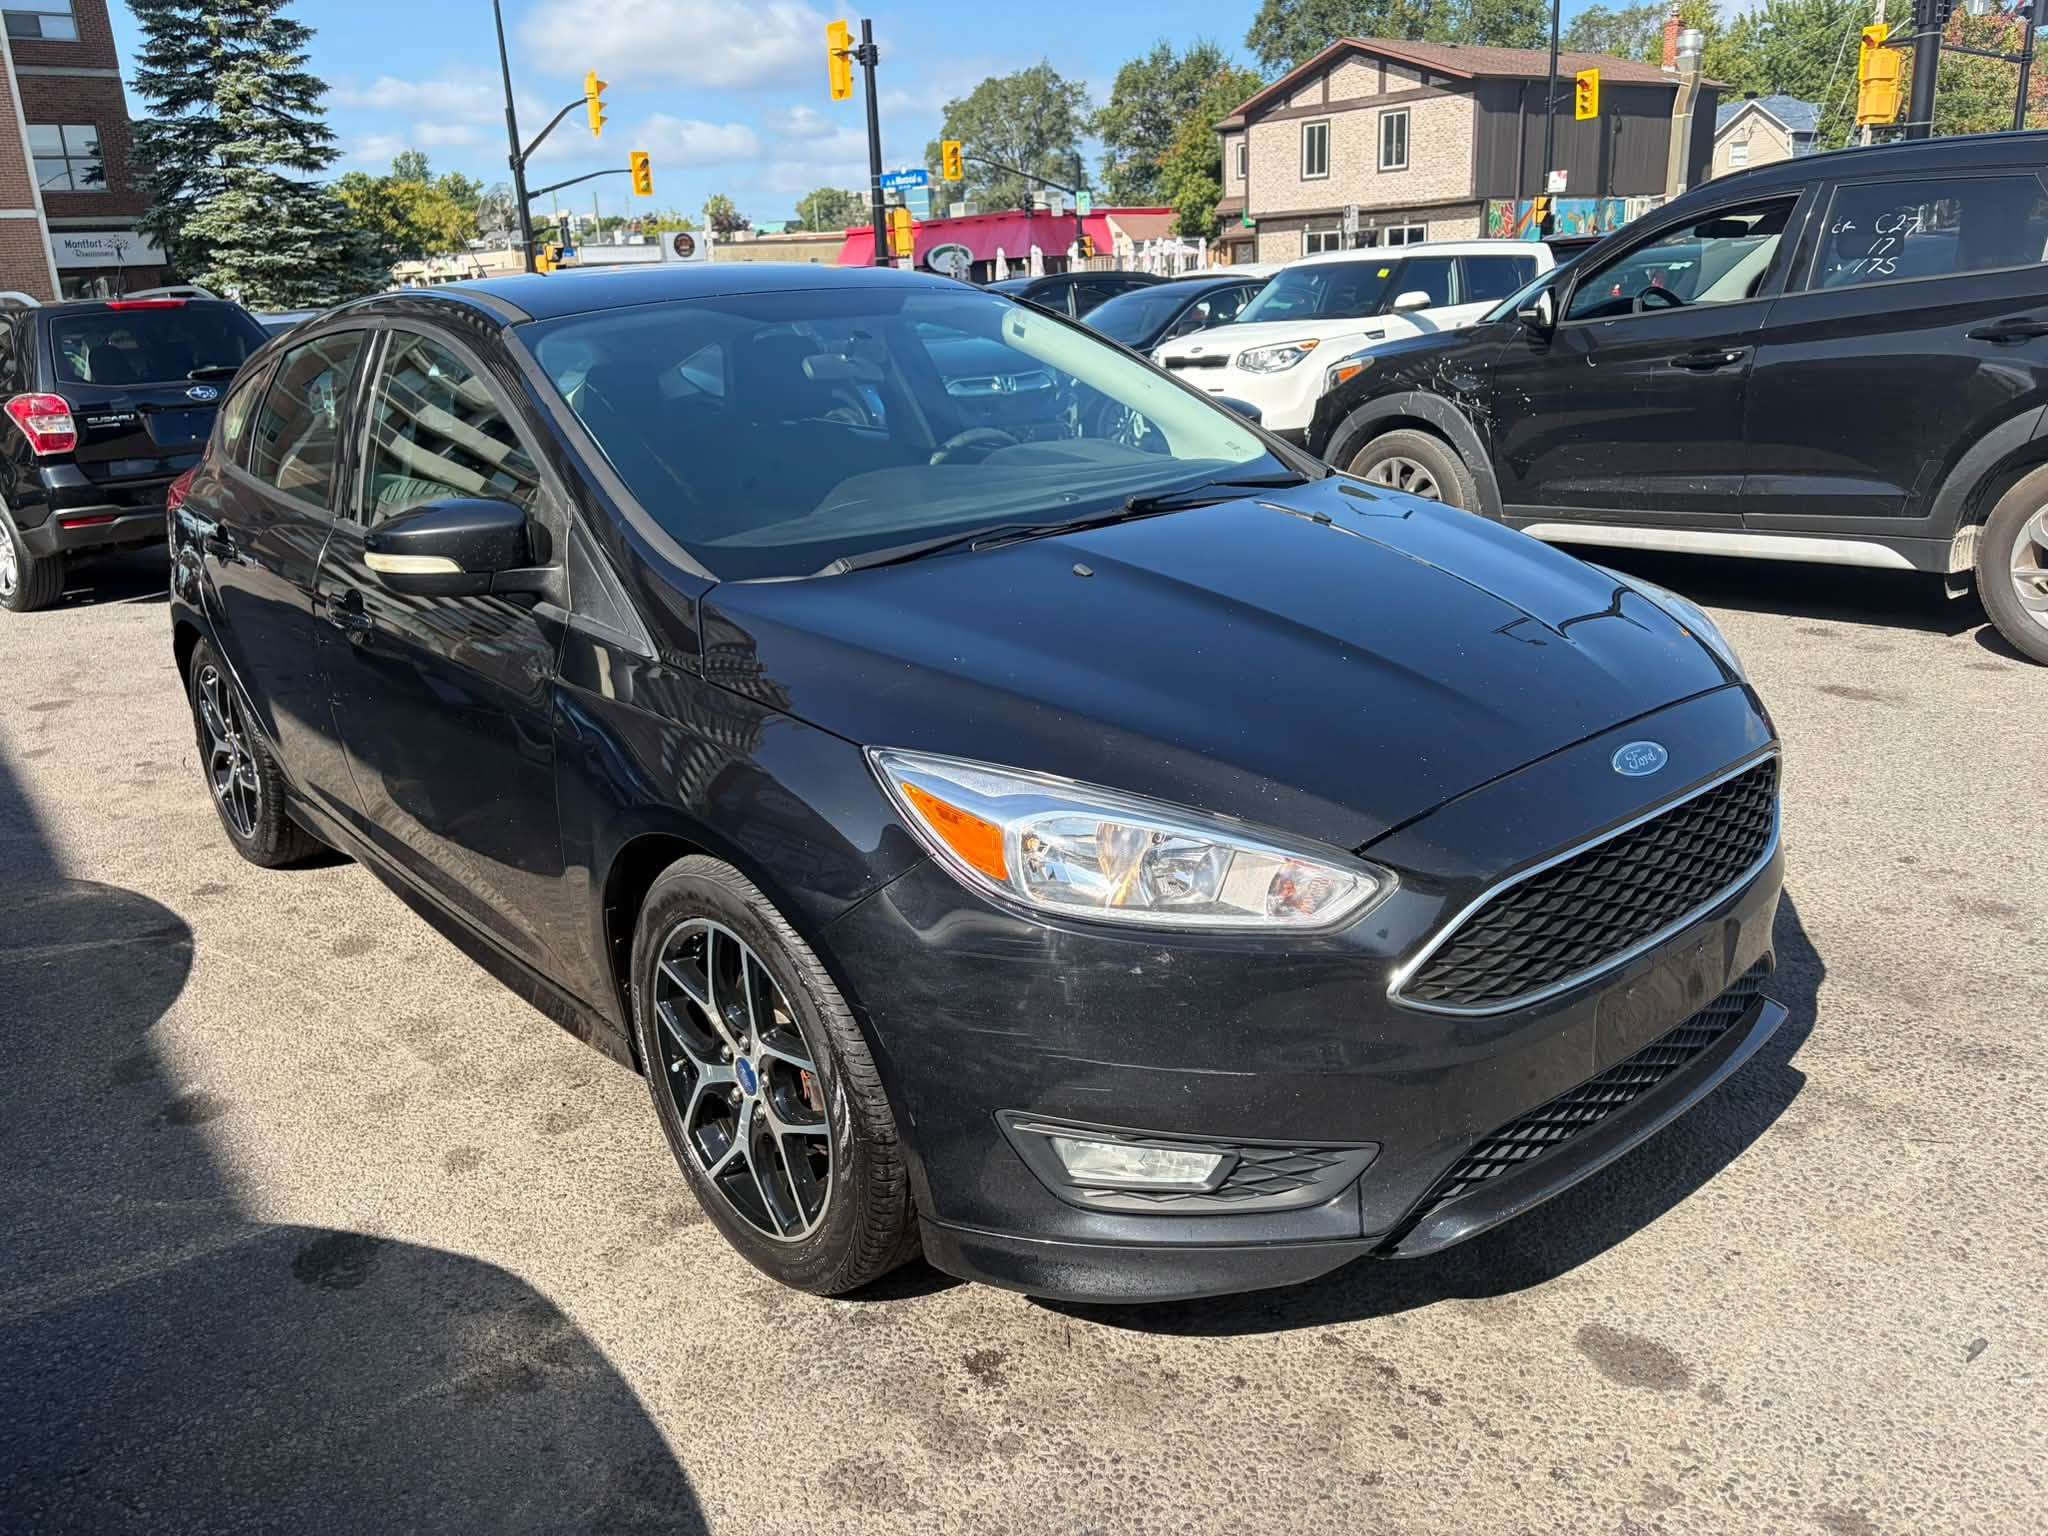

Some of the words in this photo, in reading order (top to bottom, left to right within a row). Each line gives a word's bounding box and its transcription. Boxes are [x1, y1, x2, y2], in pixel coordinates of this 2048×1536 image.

[1867, 237, 1896, 255] 17
[86, 413, 135, 424] SUBARU
[1625, 748, 1656, 769] Ford
